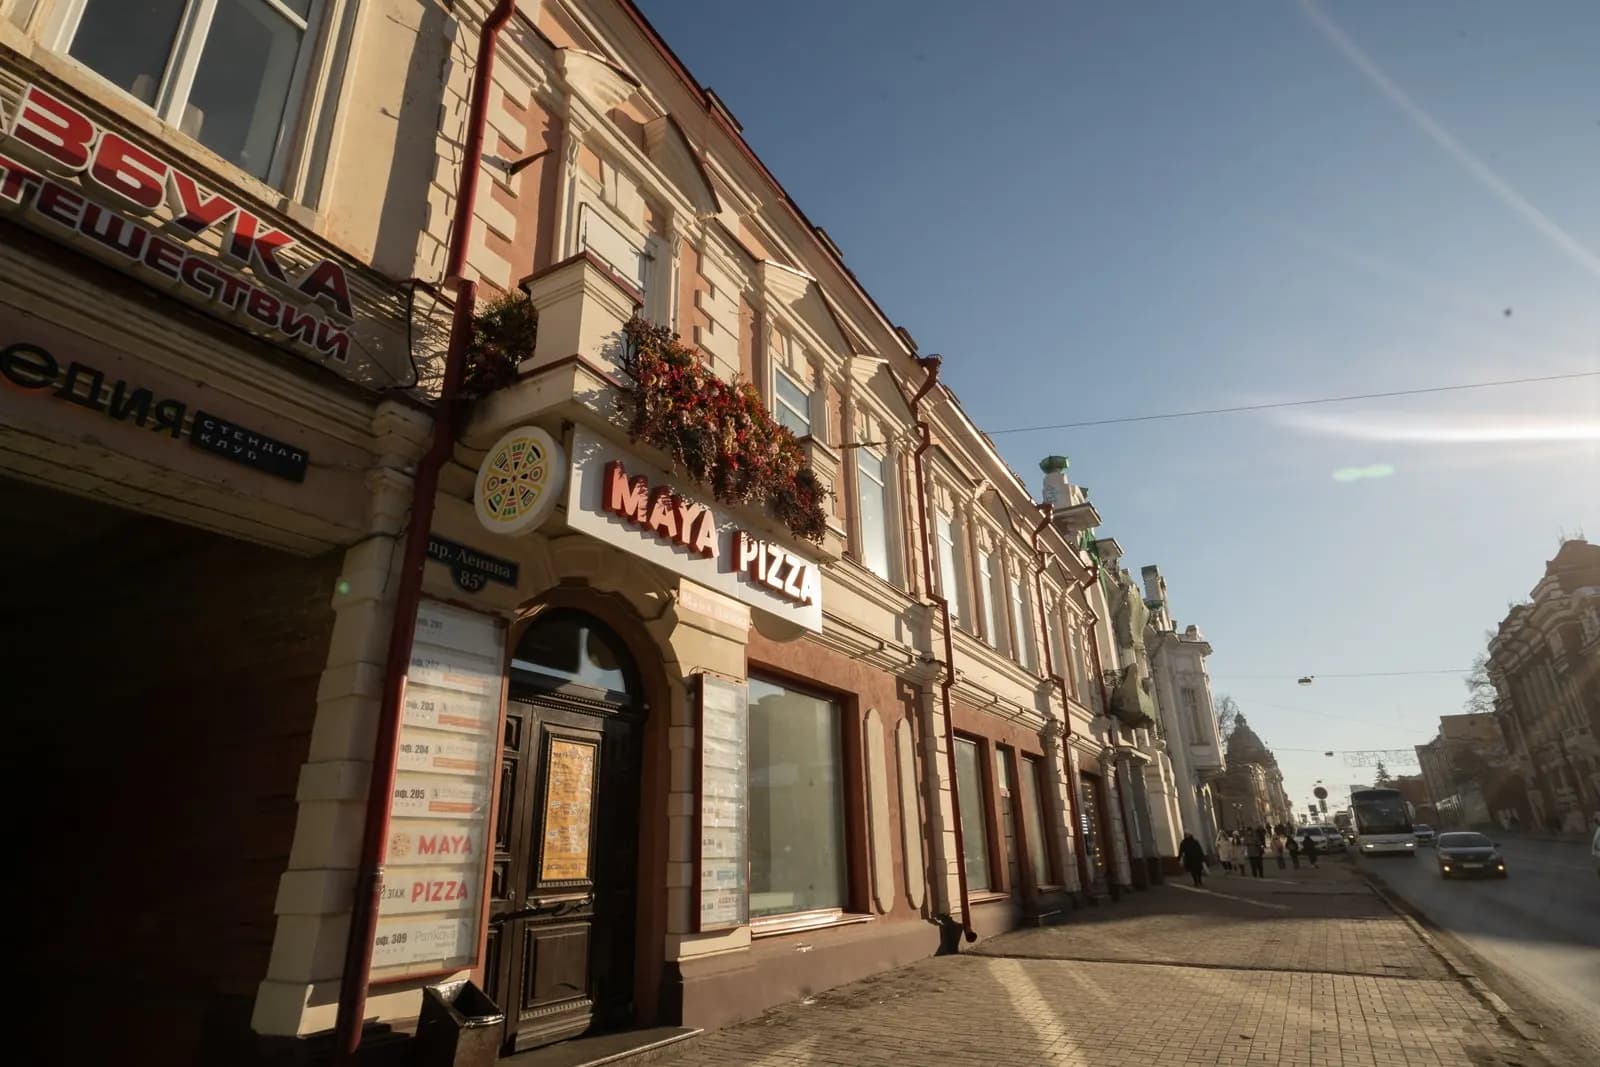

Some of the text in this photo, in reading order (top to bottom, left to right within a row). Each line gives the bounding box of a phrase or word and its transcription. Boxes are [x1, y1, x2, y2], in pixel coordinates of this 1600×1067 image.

[605, 460, 821, 605] MAYA PIZZA
[418, 835, 473, 855] MAYA
[411, 881, 468, 903] PIZZA
